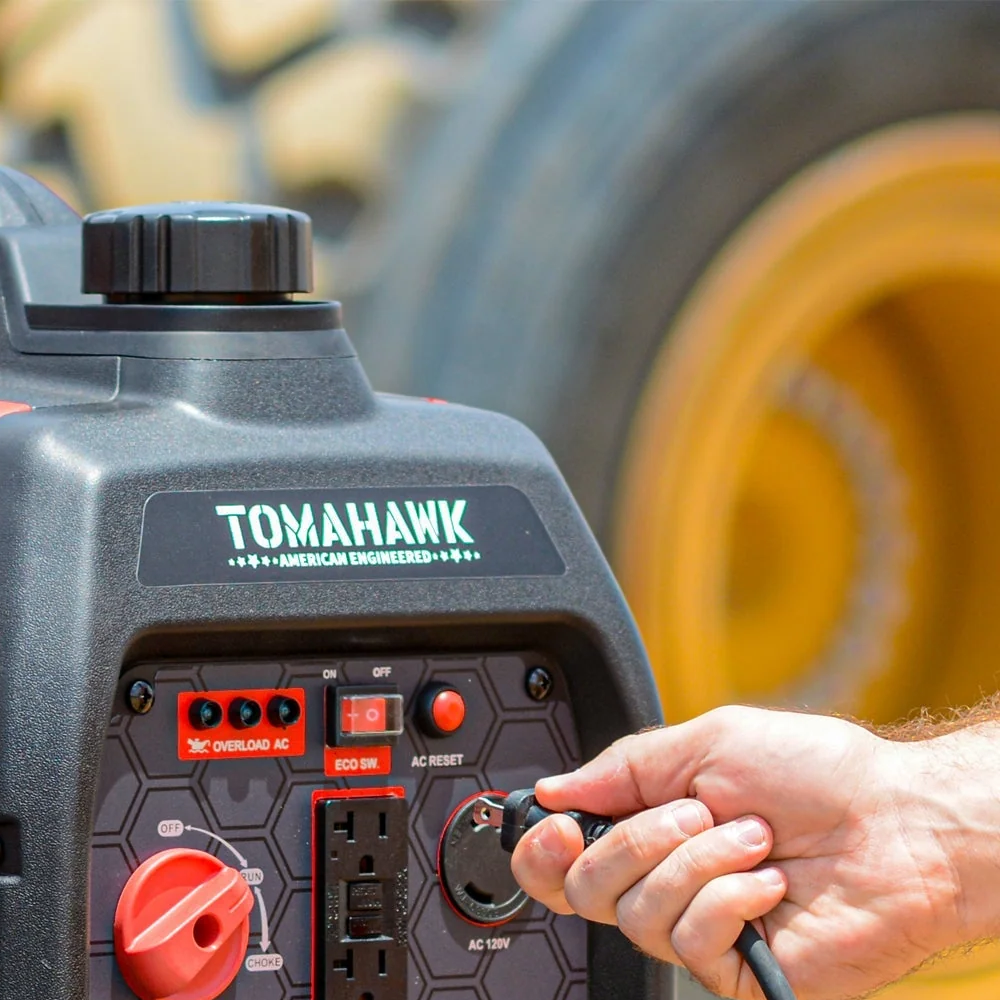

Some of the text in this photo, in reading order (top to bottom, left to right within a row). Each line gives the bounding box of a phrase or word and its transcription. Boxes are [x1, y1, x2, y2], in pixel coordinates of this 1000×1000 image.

[215, 499, 474, 550] TOMAHAWK
[279, 549, 432, 568] AMERICAN ENGINEERED
[322, 669, 337, 680] ON
[372, 666, 392, 678] OFF
[213, 738, 290, 753] OVERLOAD AC
[334, 758, 358, 771] ECO
[411, 754, 464, 768] AC RESET
[160, 824, 181, 834] OFF
[468, 937, 511, 951] AC 120V
[247, 956, 282, 969] CHOKE
